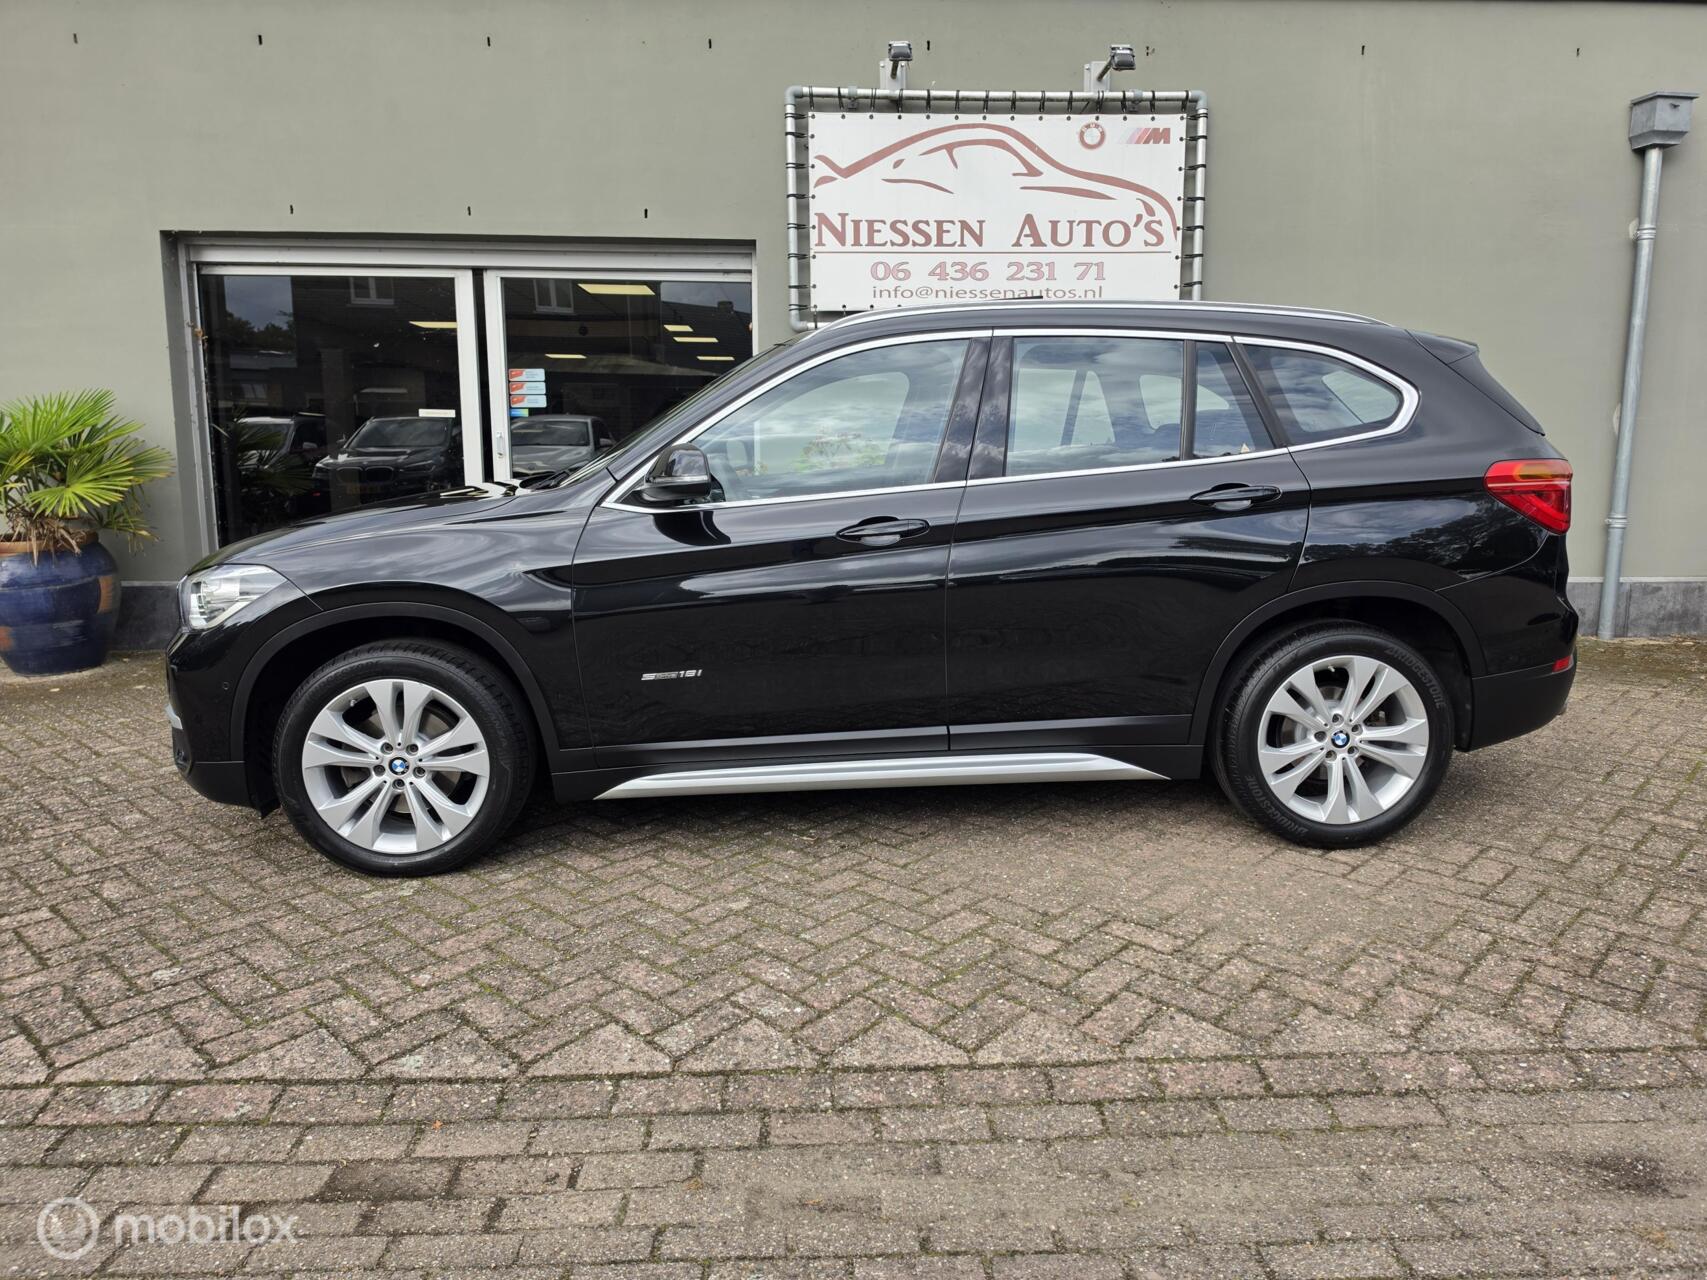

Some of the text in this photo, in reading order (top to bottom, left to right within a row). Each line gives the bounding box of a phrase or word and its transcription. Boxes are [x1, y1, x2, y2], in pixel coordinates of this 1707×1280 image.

[813, 212, 1165, 248] NIESSEN AUTO'S
[870, 260, 1106, 281] 06 436 231 71
[872, 285, 1103, 299] info@niessenautos.nl
